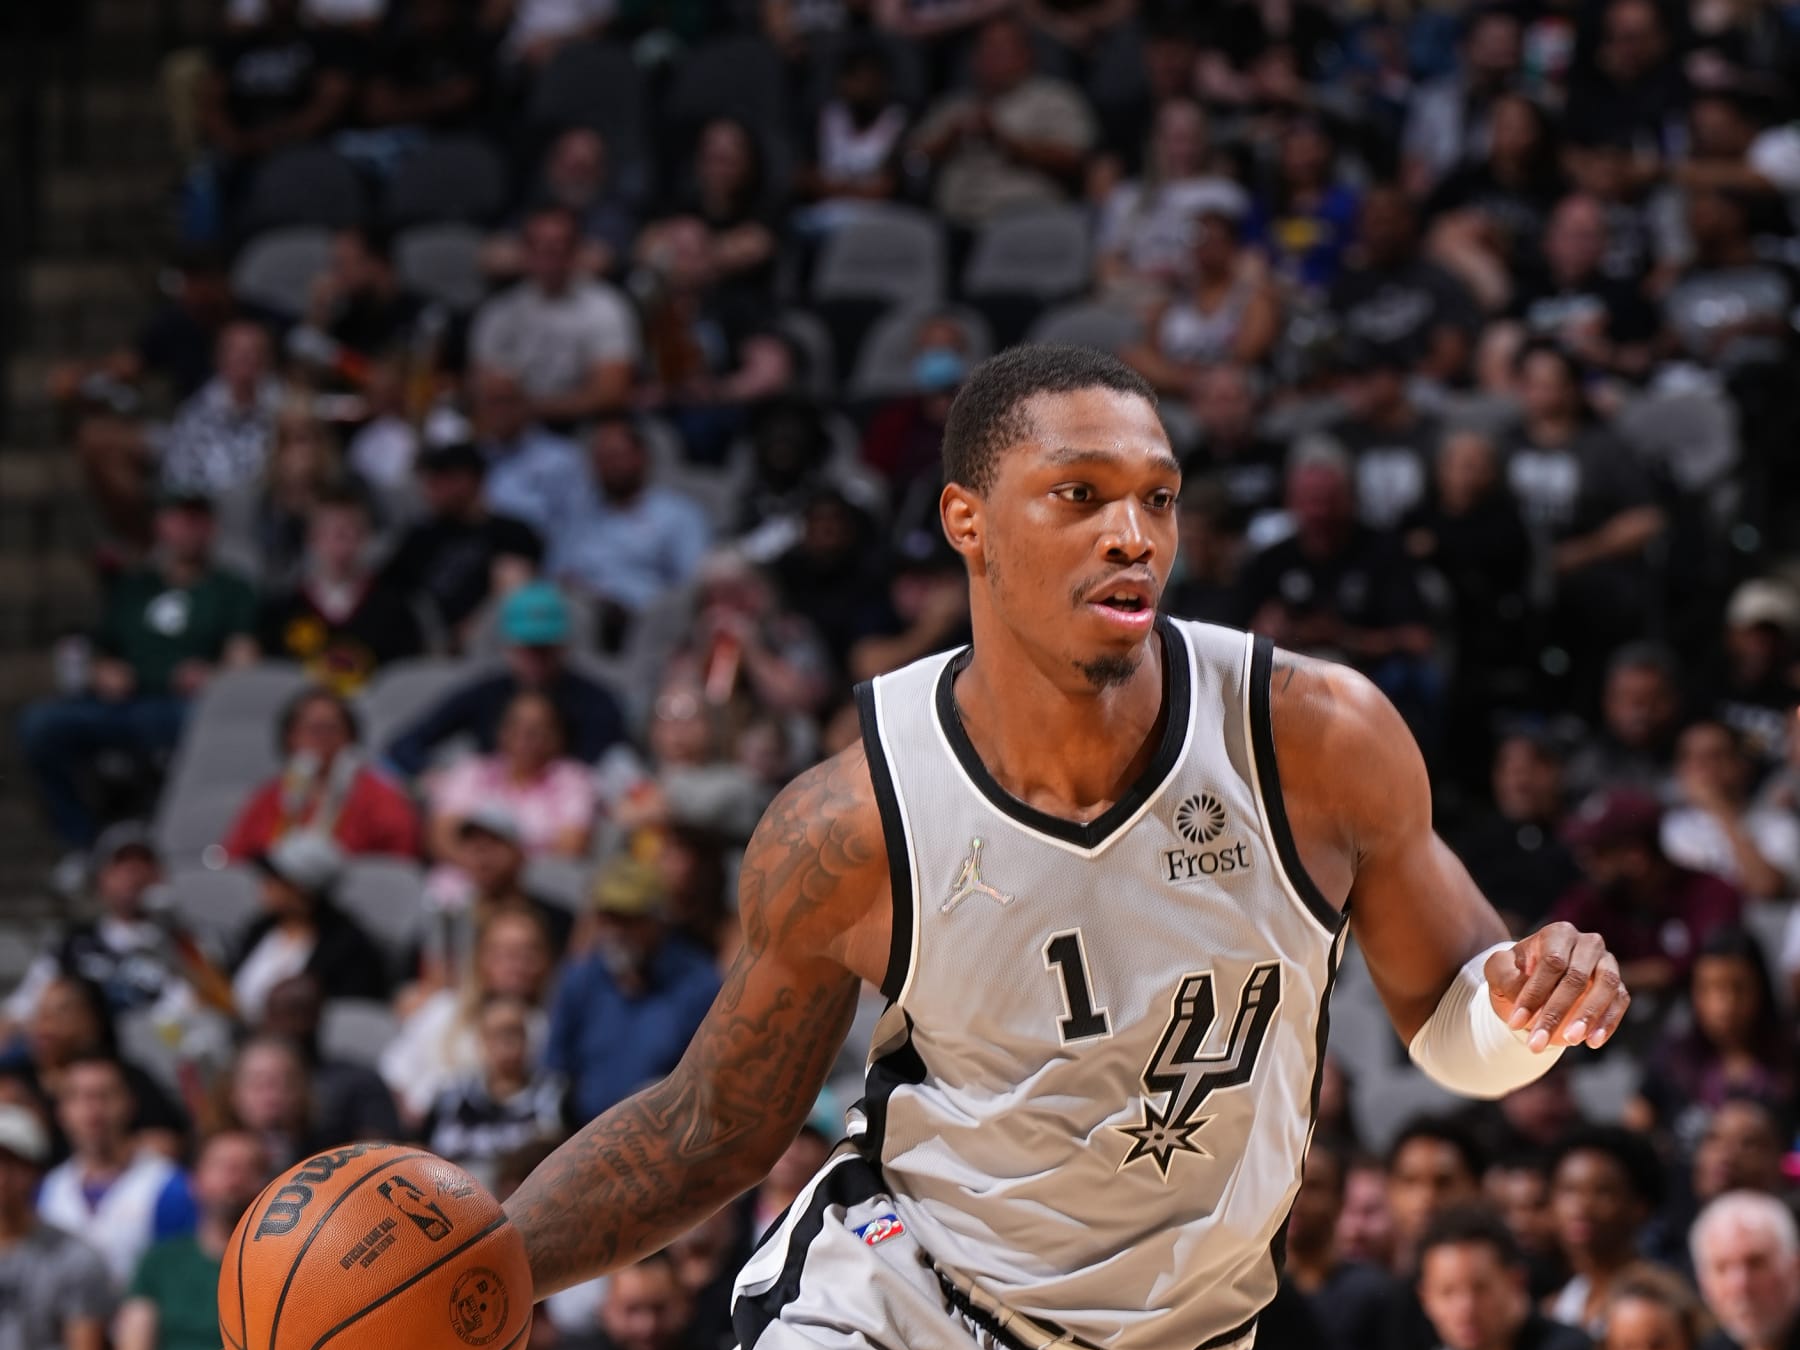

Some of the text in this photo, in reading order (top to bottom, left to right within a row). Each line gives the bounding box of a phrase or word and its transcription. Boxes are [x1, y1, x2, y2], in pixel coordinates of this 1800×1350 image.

[1164, 841, 1250, 881] Frost
[1043, 929, 1112, 1046] 1
[253, 1144, 391, 1242] Wils
